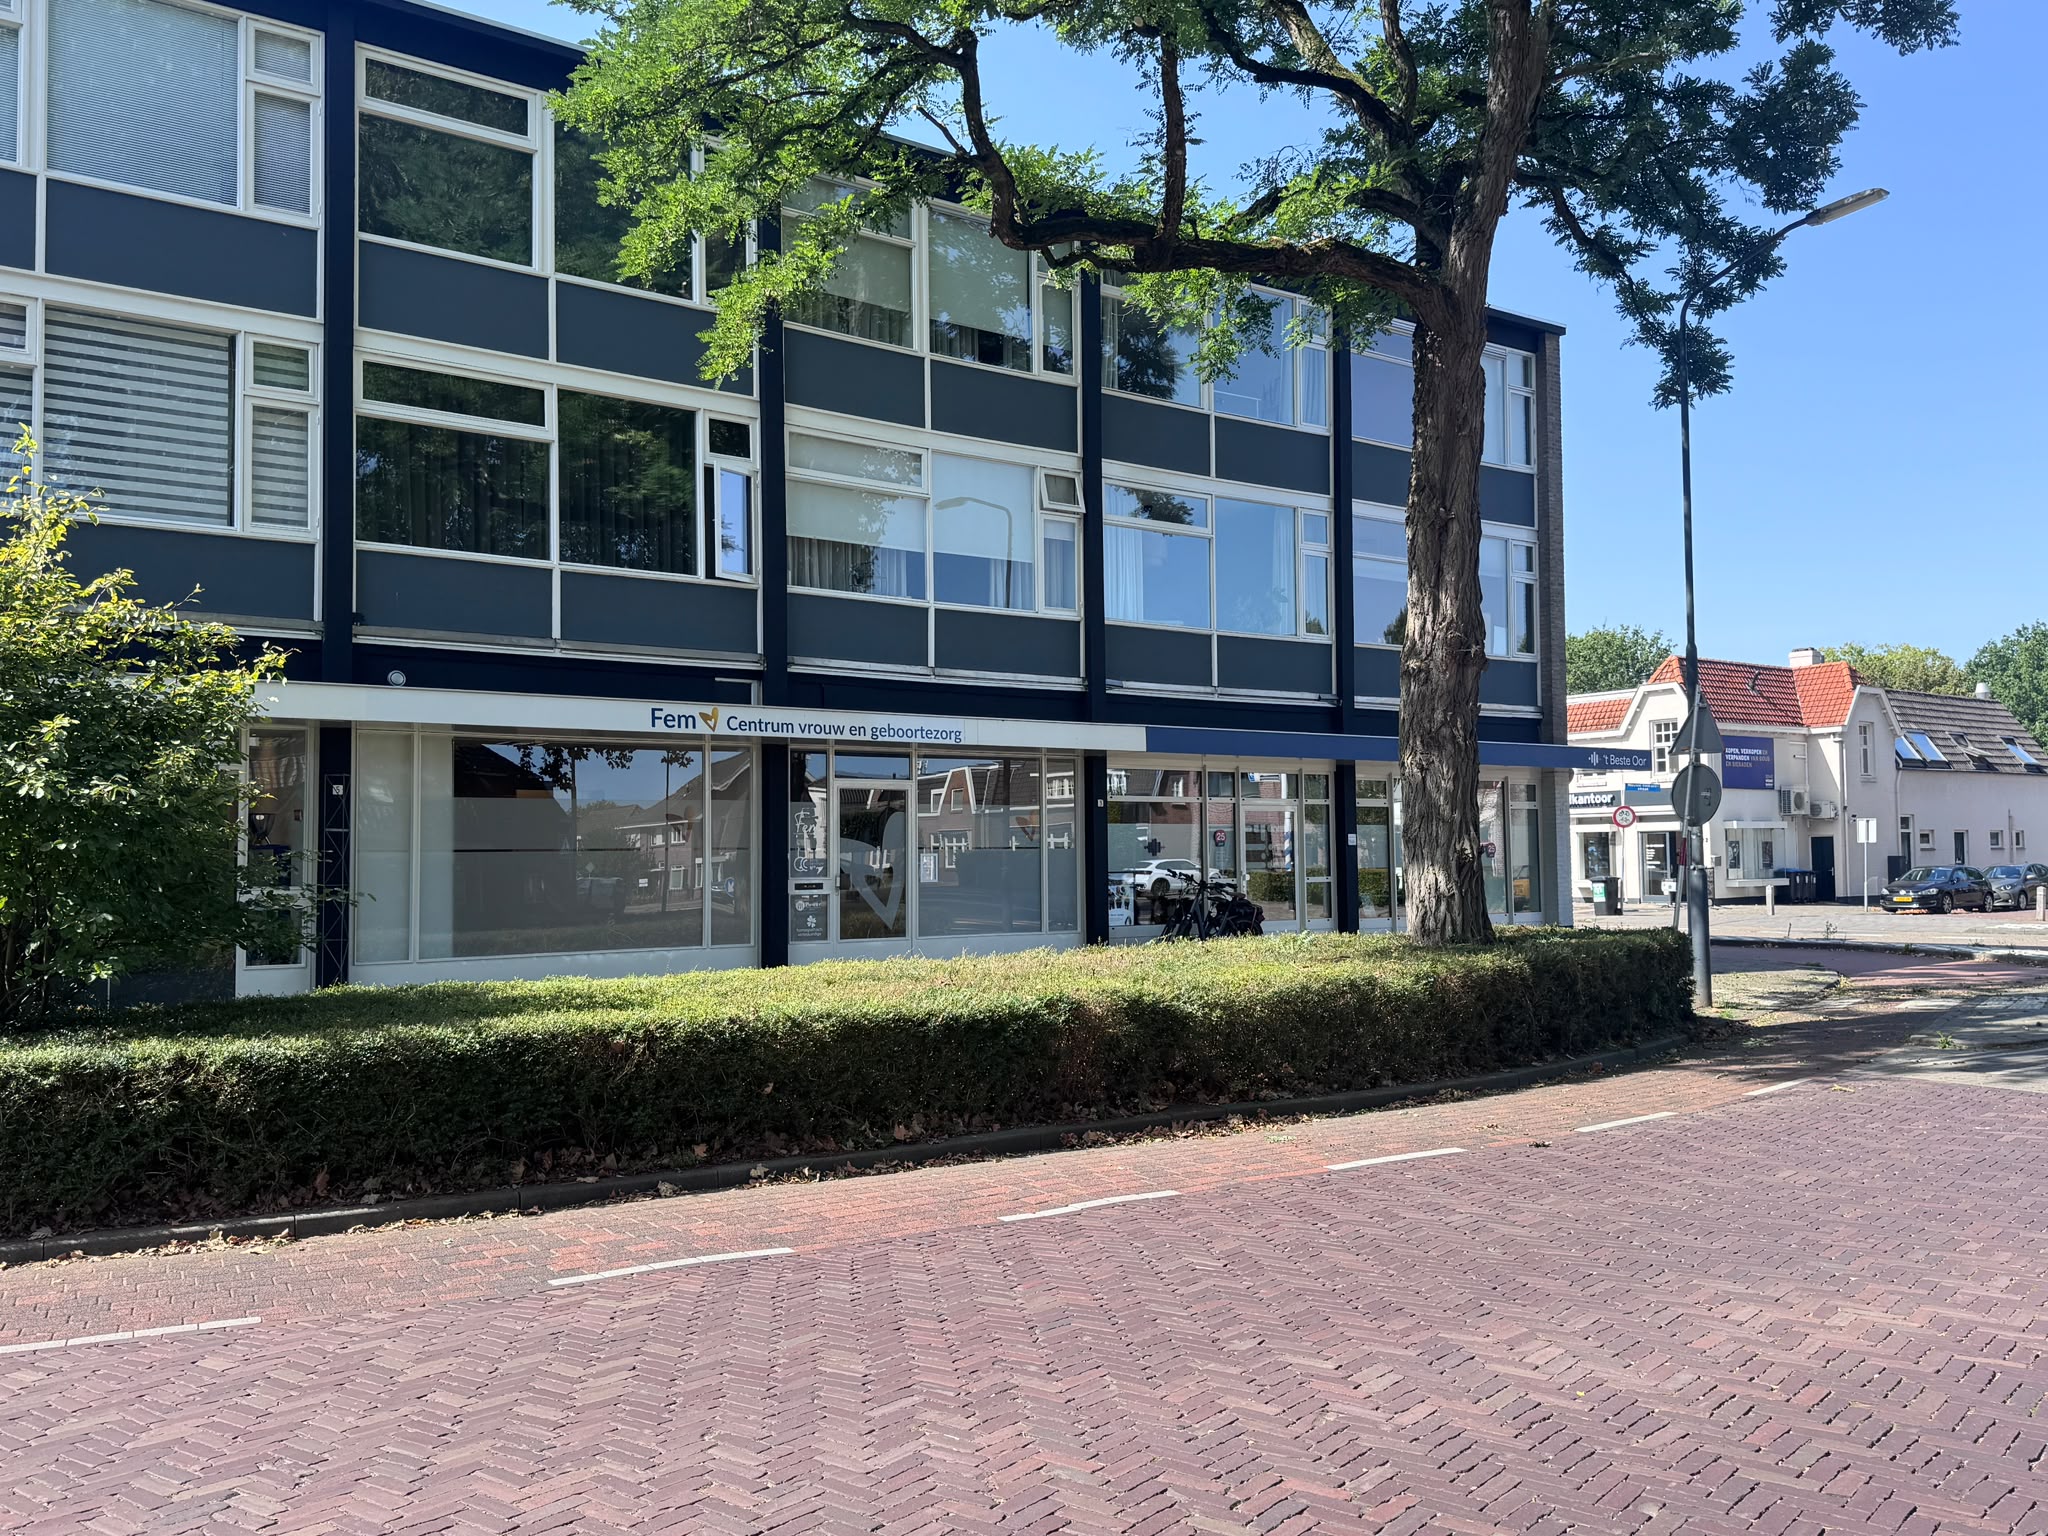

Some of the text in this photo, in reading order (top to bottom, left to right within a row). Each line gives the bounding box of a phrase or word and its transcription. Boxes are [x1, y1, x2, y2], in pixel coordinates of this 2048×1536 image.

[651, 707, 697, 729] Fem
[726, 715, 962, 743] Centrum vrouw en geboortezorg
[1610, 754, 1631, 766] Beste
[1632, 755, 1647, 766] Oor
